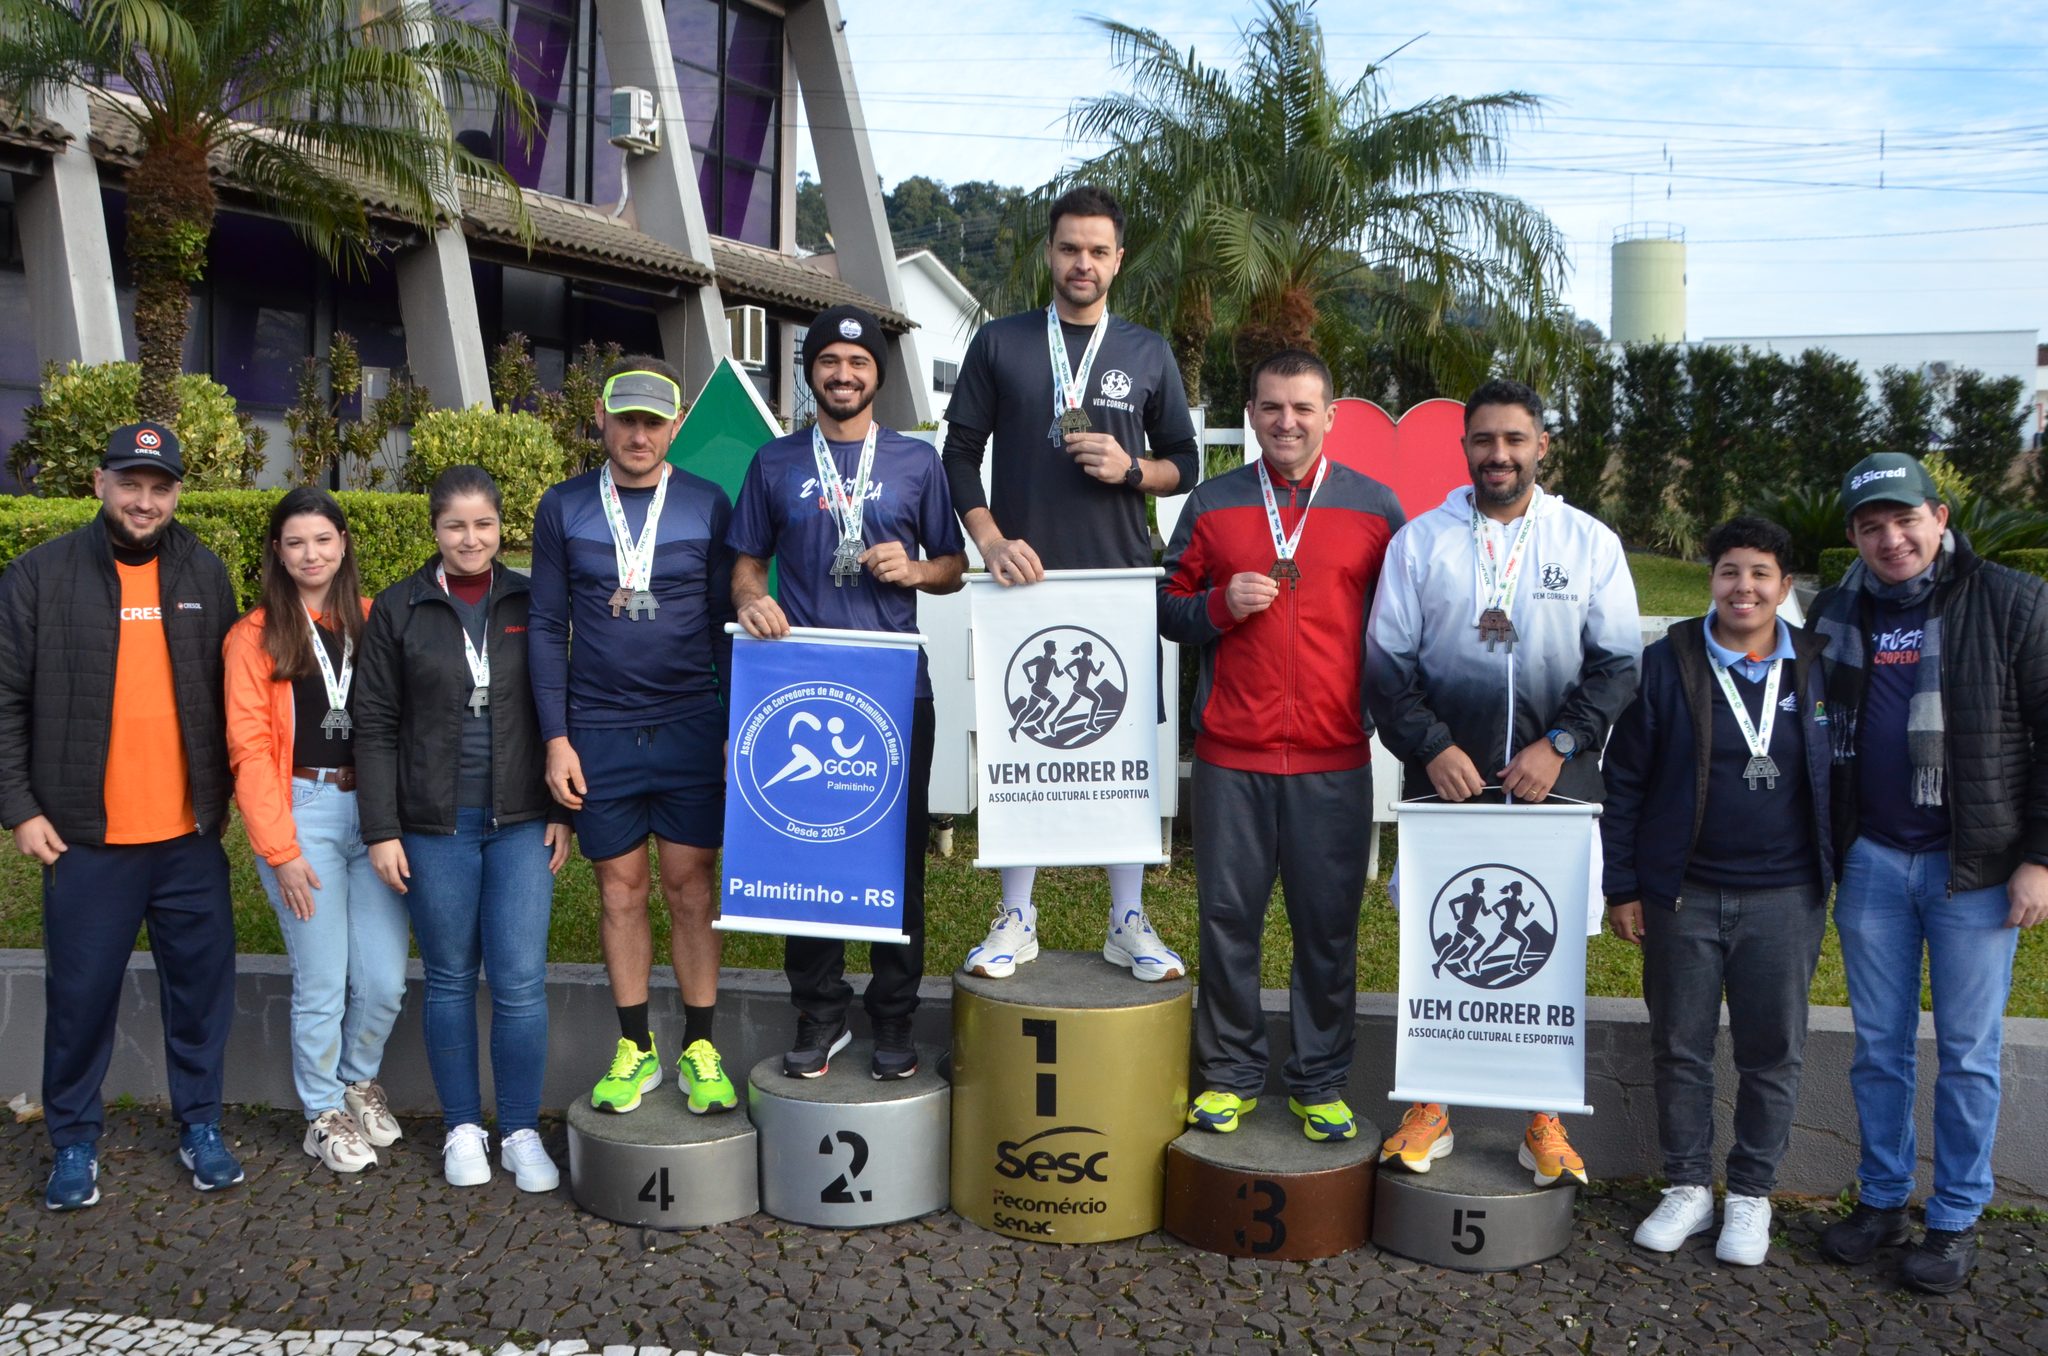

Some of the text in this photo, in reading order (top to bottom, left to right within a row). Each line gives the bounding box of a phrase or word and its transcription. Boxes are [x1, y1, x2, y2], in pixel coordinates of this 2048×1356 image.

[1093, 398, 1106, 407] VEM
[134, 448, 162, 457] CRESOL
[1862, 467, 1907, 484] Sicredi
[1532, 592, 1545, 600] VEM
[740, 713, 765, 756] Associação
[762, 704, 773, 715] de
[771, 687, 815, 708] Corredores
[817, 686, 827, 696] de
[829, 687, 844, 699] Rua
[845, 693, 856, 703] de
[855, 697, 889, 732] Palmitinho
[887, 737, 900, 766] Região
[988, 759, 1149, 785] VEM CORRER RB
[827, 780, 875, 793] Palmitinho
[988, 788, 1150, 804] ASSOCIAÇÃO CULTURAL E ESPORTIVA
[786, 821, 846, 838] Desde 2025
[729, 877, 844, 904] Palmitinho
[864, 888, 895, 908] RS
[1409, 997, 1575, 1027] VEM CORRER RB
[1408, 1027, 1575, 1046] ASSOCIAÇÃO CULTURAL E ESPORTIVA
[1021, 1018, 1057, 1117] 1
[818, 1129, 873, 1204] 2
[994, 1138, 1109, 1184] Sesc
[637, 1167, 675, 1211] 4
[993, 1212, 1052, 1237] Senac
[1234, 1179, 1287, 1255] 3
[1451, 1209, 1487, 1256] 5
